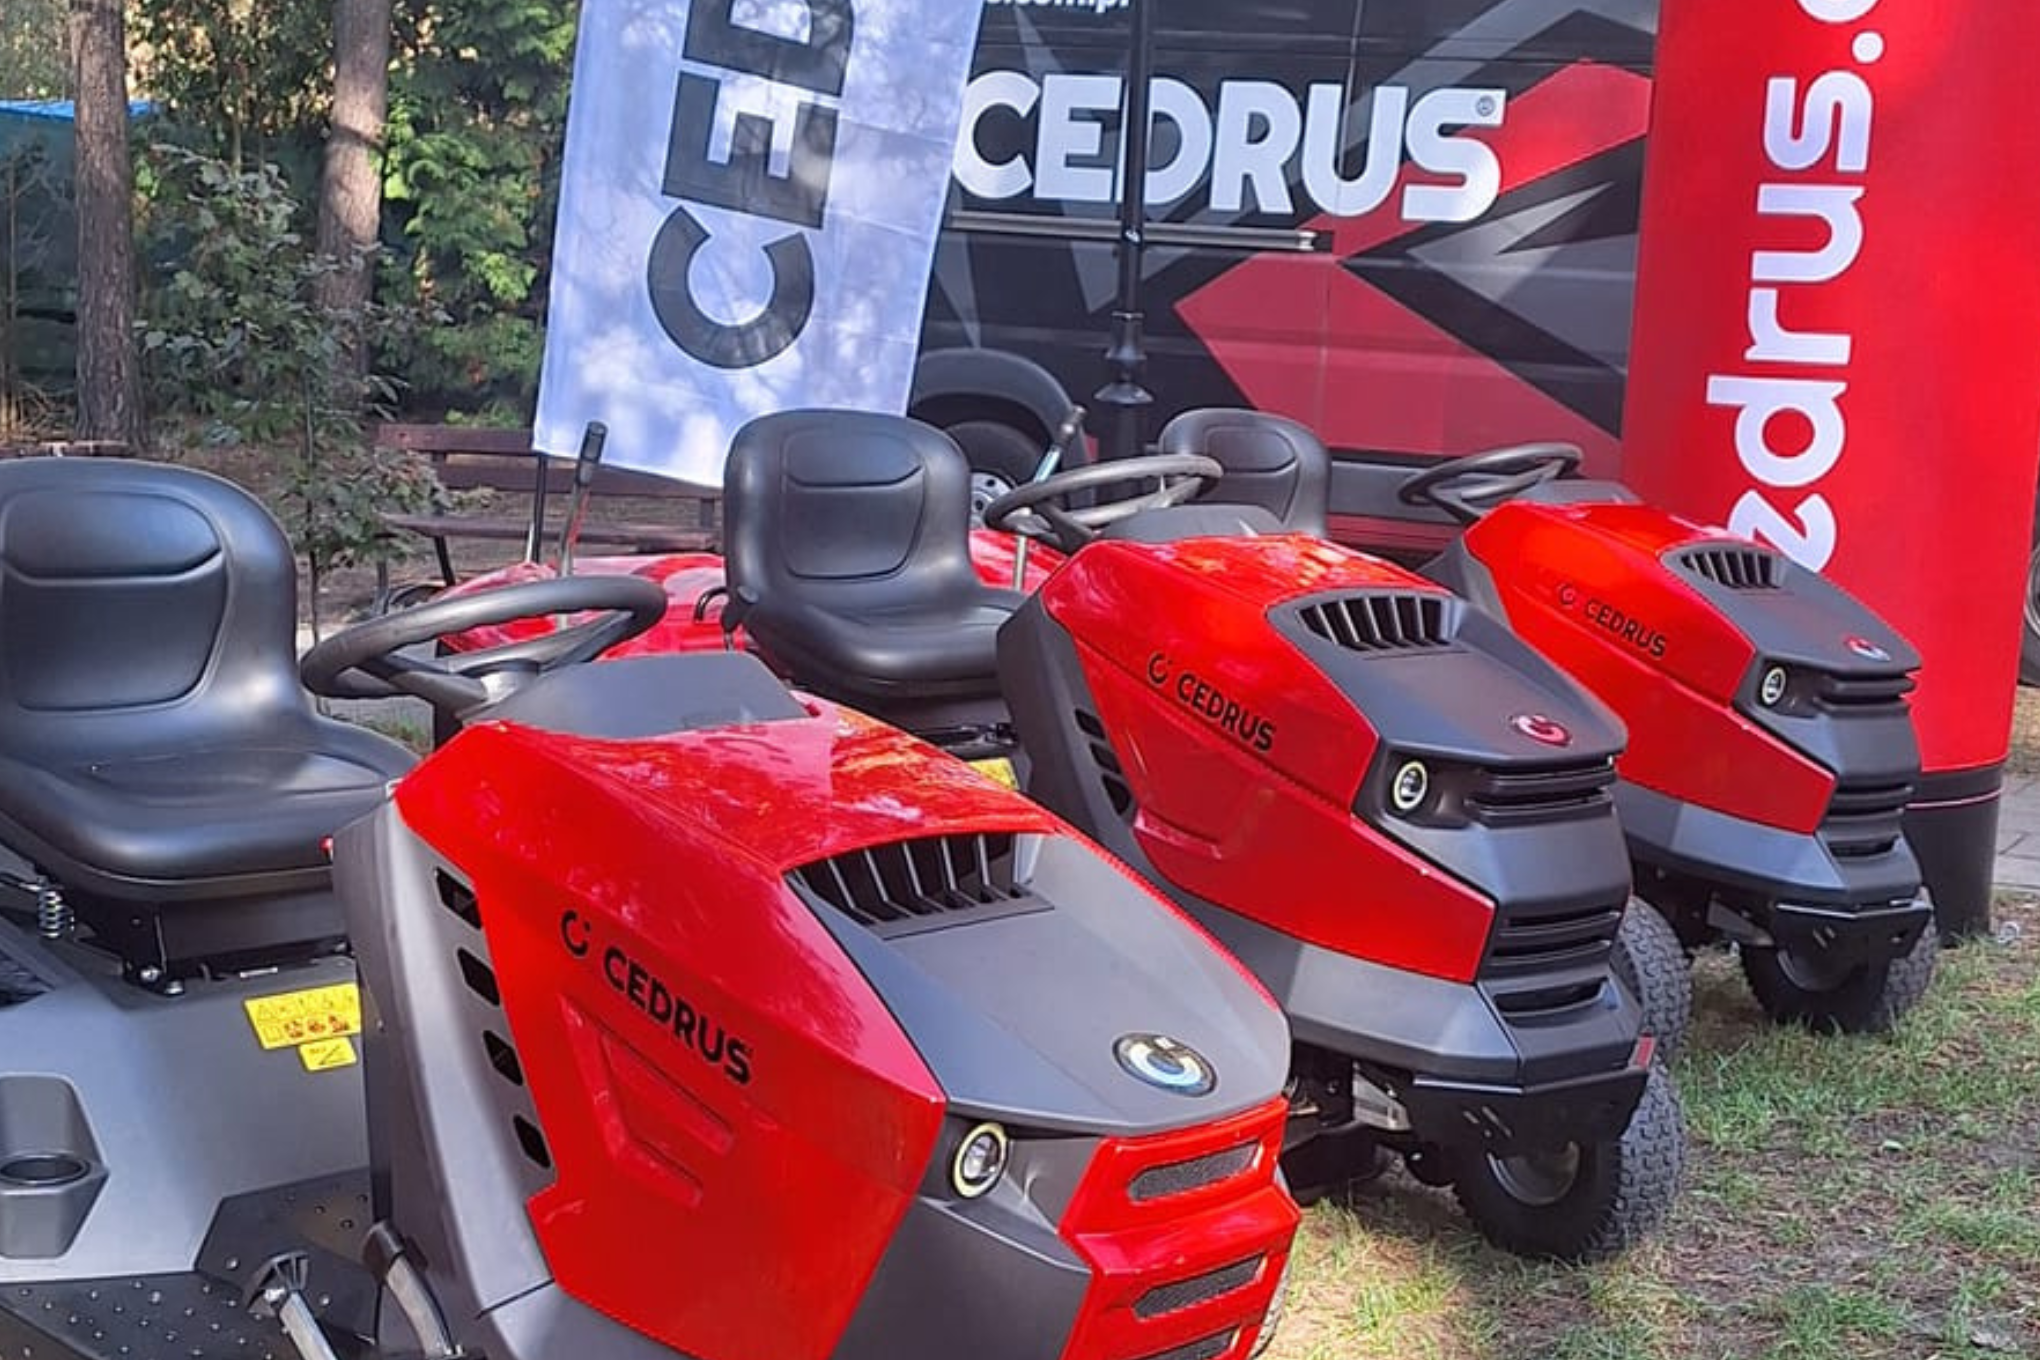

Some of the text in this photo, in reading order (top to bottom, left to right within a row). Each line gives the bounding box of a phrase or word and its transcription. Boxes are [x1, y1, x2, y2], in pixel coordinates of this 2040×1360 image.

[951, 71, 1507, 222] CEDRUS
[1705, 0, 1884, 572] edrus.
[1585, 598, 1667, 657] CEDRUS
[1177, 673, 1275, 751] CEDRUS
[603, 946, 752, 1085] CEDRUS
